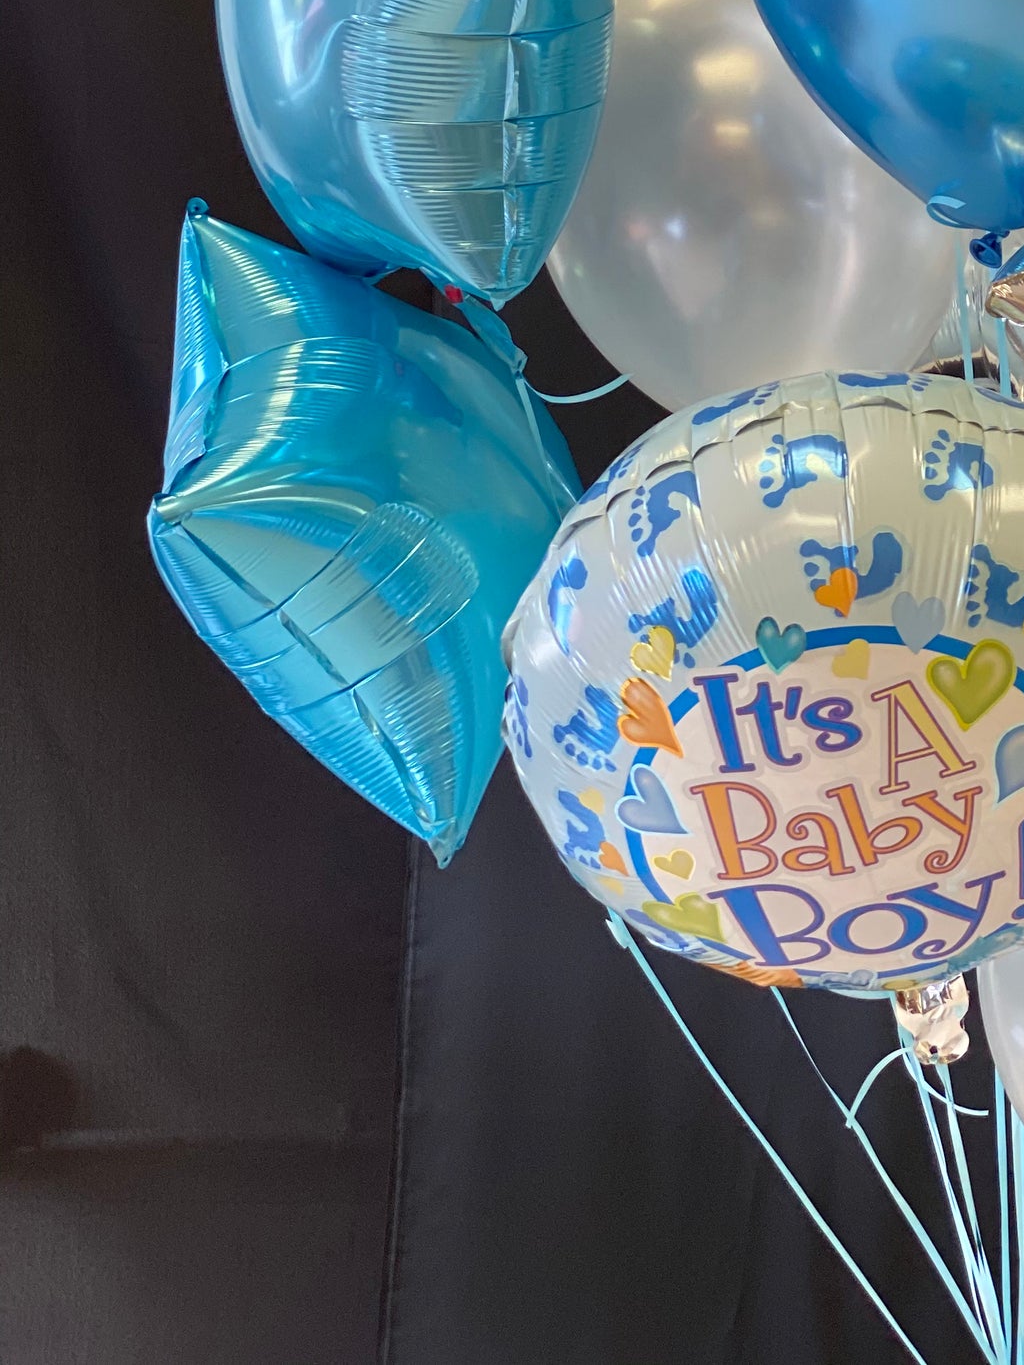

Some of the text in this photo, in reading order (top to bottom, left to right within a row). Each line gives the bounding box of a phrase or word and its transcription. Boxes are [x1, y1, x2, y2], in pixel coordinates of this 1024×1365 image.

[693, 672, 977, 795] It's A
[689, 781, 983, 881] Baby
